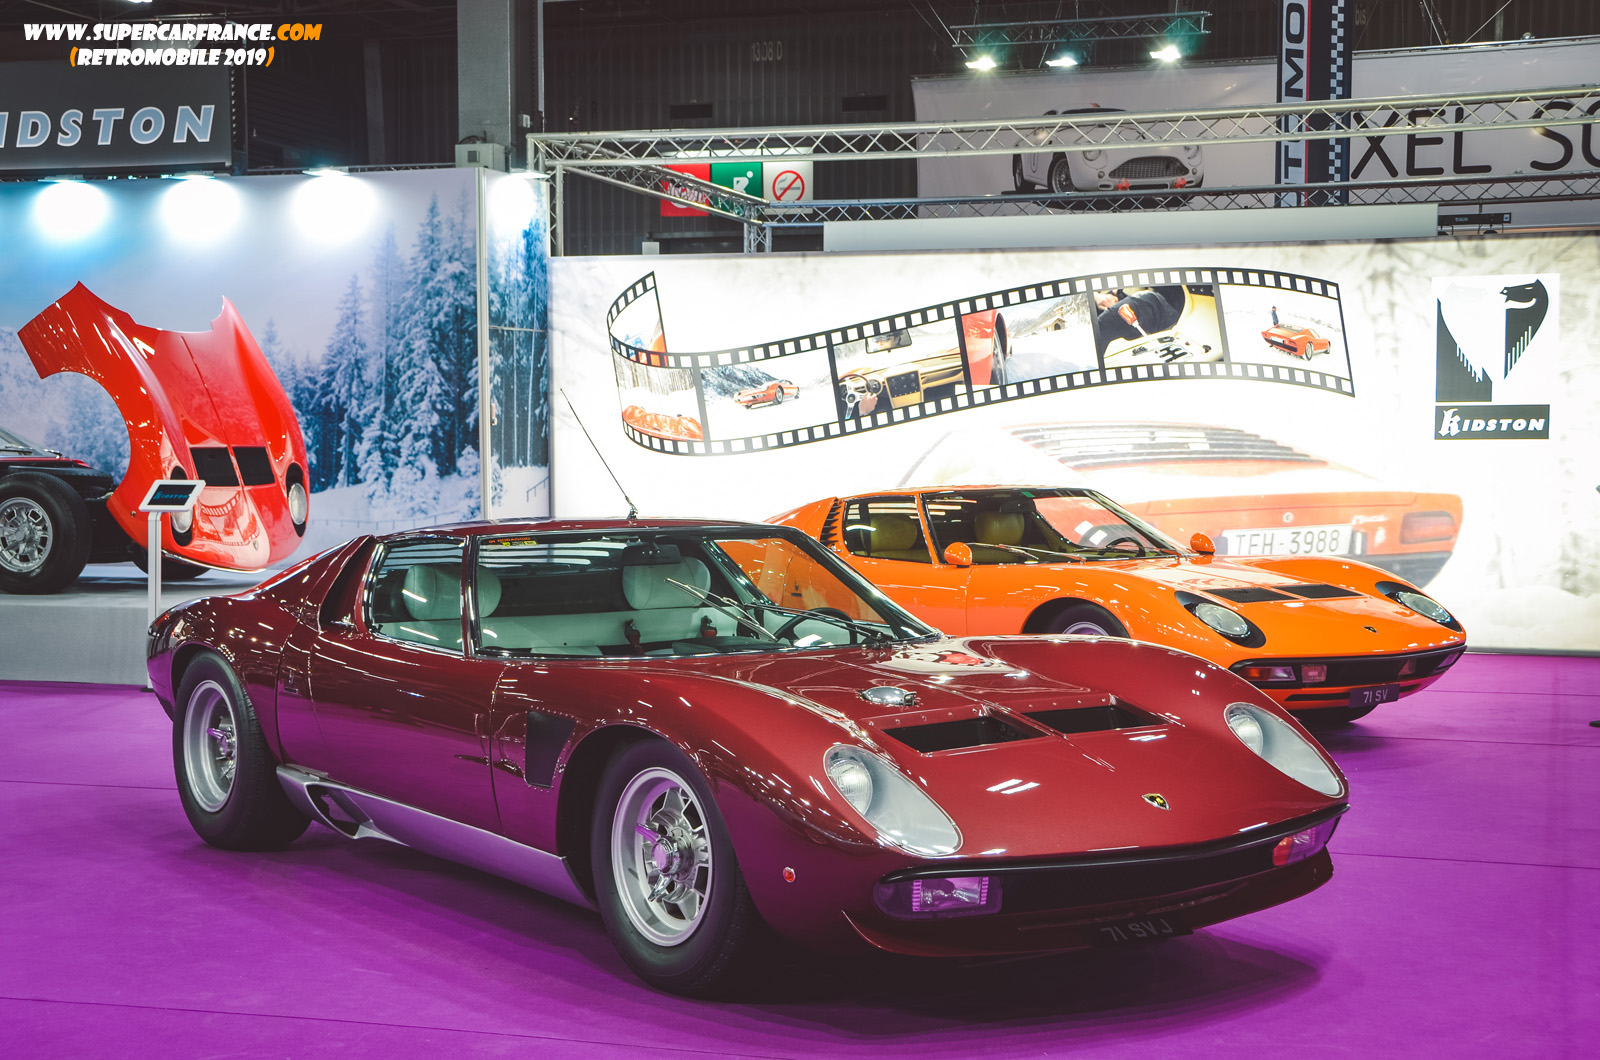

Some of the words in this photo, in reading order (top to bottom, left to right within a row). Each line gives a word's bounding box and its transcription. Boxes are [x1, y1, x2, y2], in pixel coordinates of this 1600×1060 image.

[1438, 407, 1546, 437] KIDSTON
[1363, 690, 1373, 703] 71
[1375, 689, 1388, 702] SV
[1100, 925, 1128, 942] 71
